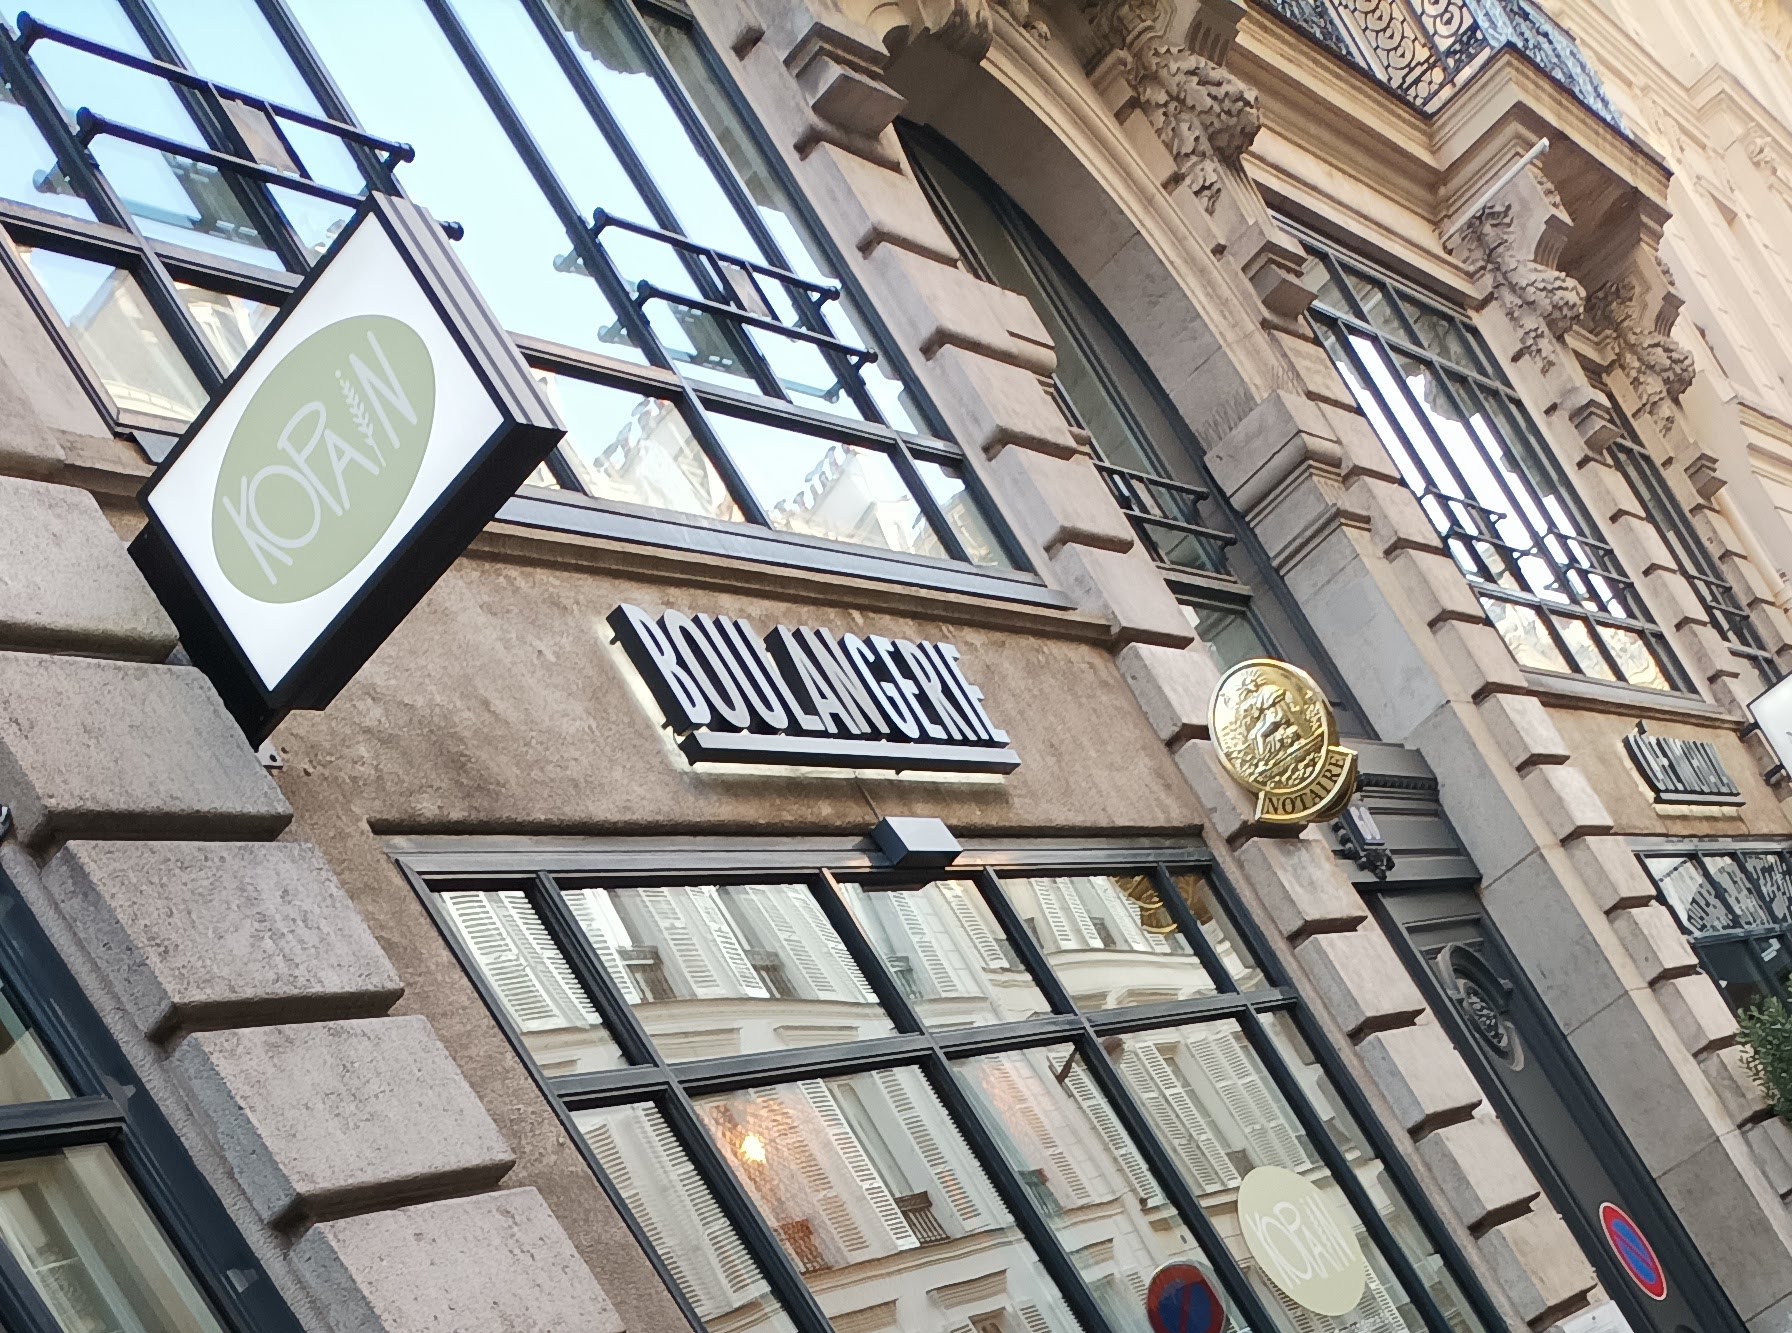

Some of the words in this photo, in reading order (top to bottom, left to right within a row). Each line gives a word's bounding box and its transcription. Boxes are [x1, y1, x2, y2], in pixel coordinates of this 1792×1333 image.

[222, 330, 418, 585] KOPAIN
[610, 603, 1011, 748] BOULANGERIE
[1265, 753, 1347, 816] NOTAIRE
